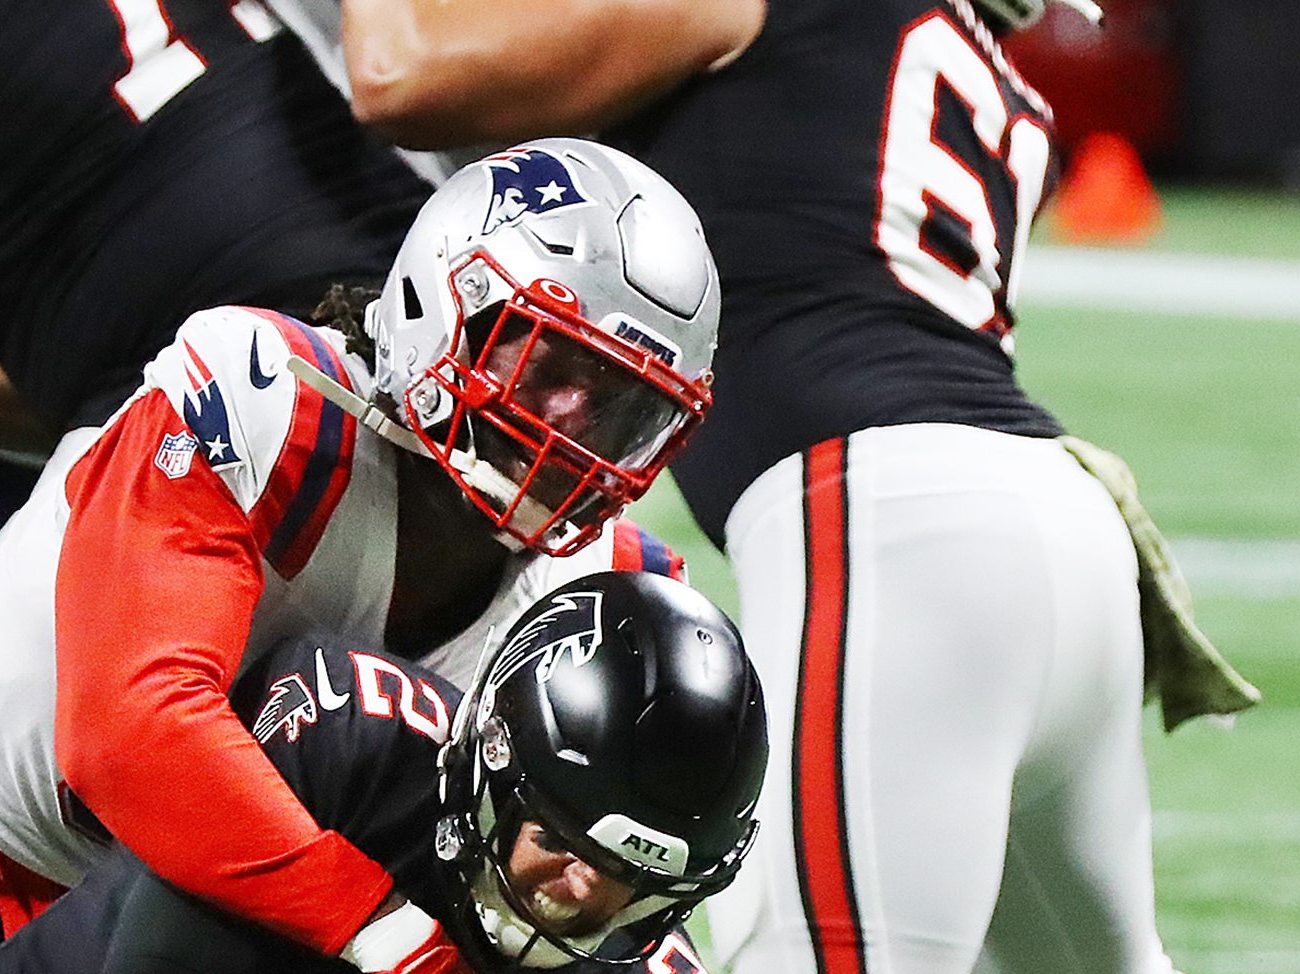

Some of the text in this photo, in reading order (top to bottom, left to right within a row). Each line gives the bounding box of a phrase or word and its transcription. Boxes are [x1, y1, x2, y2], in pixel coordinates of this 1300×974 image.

[873, 8, 1051, 354] 61
[161, 450, 186, 473] NFL
[348, 650, 450, 746] 2
[620, 833, 671, 862] ATL
